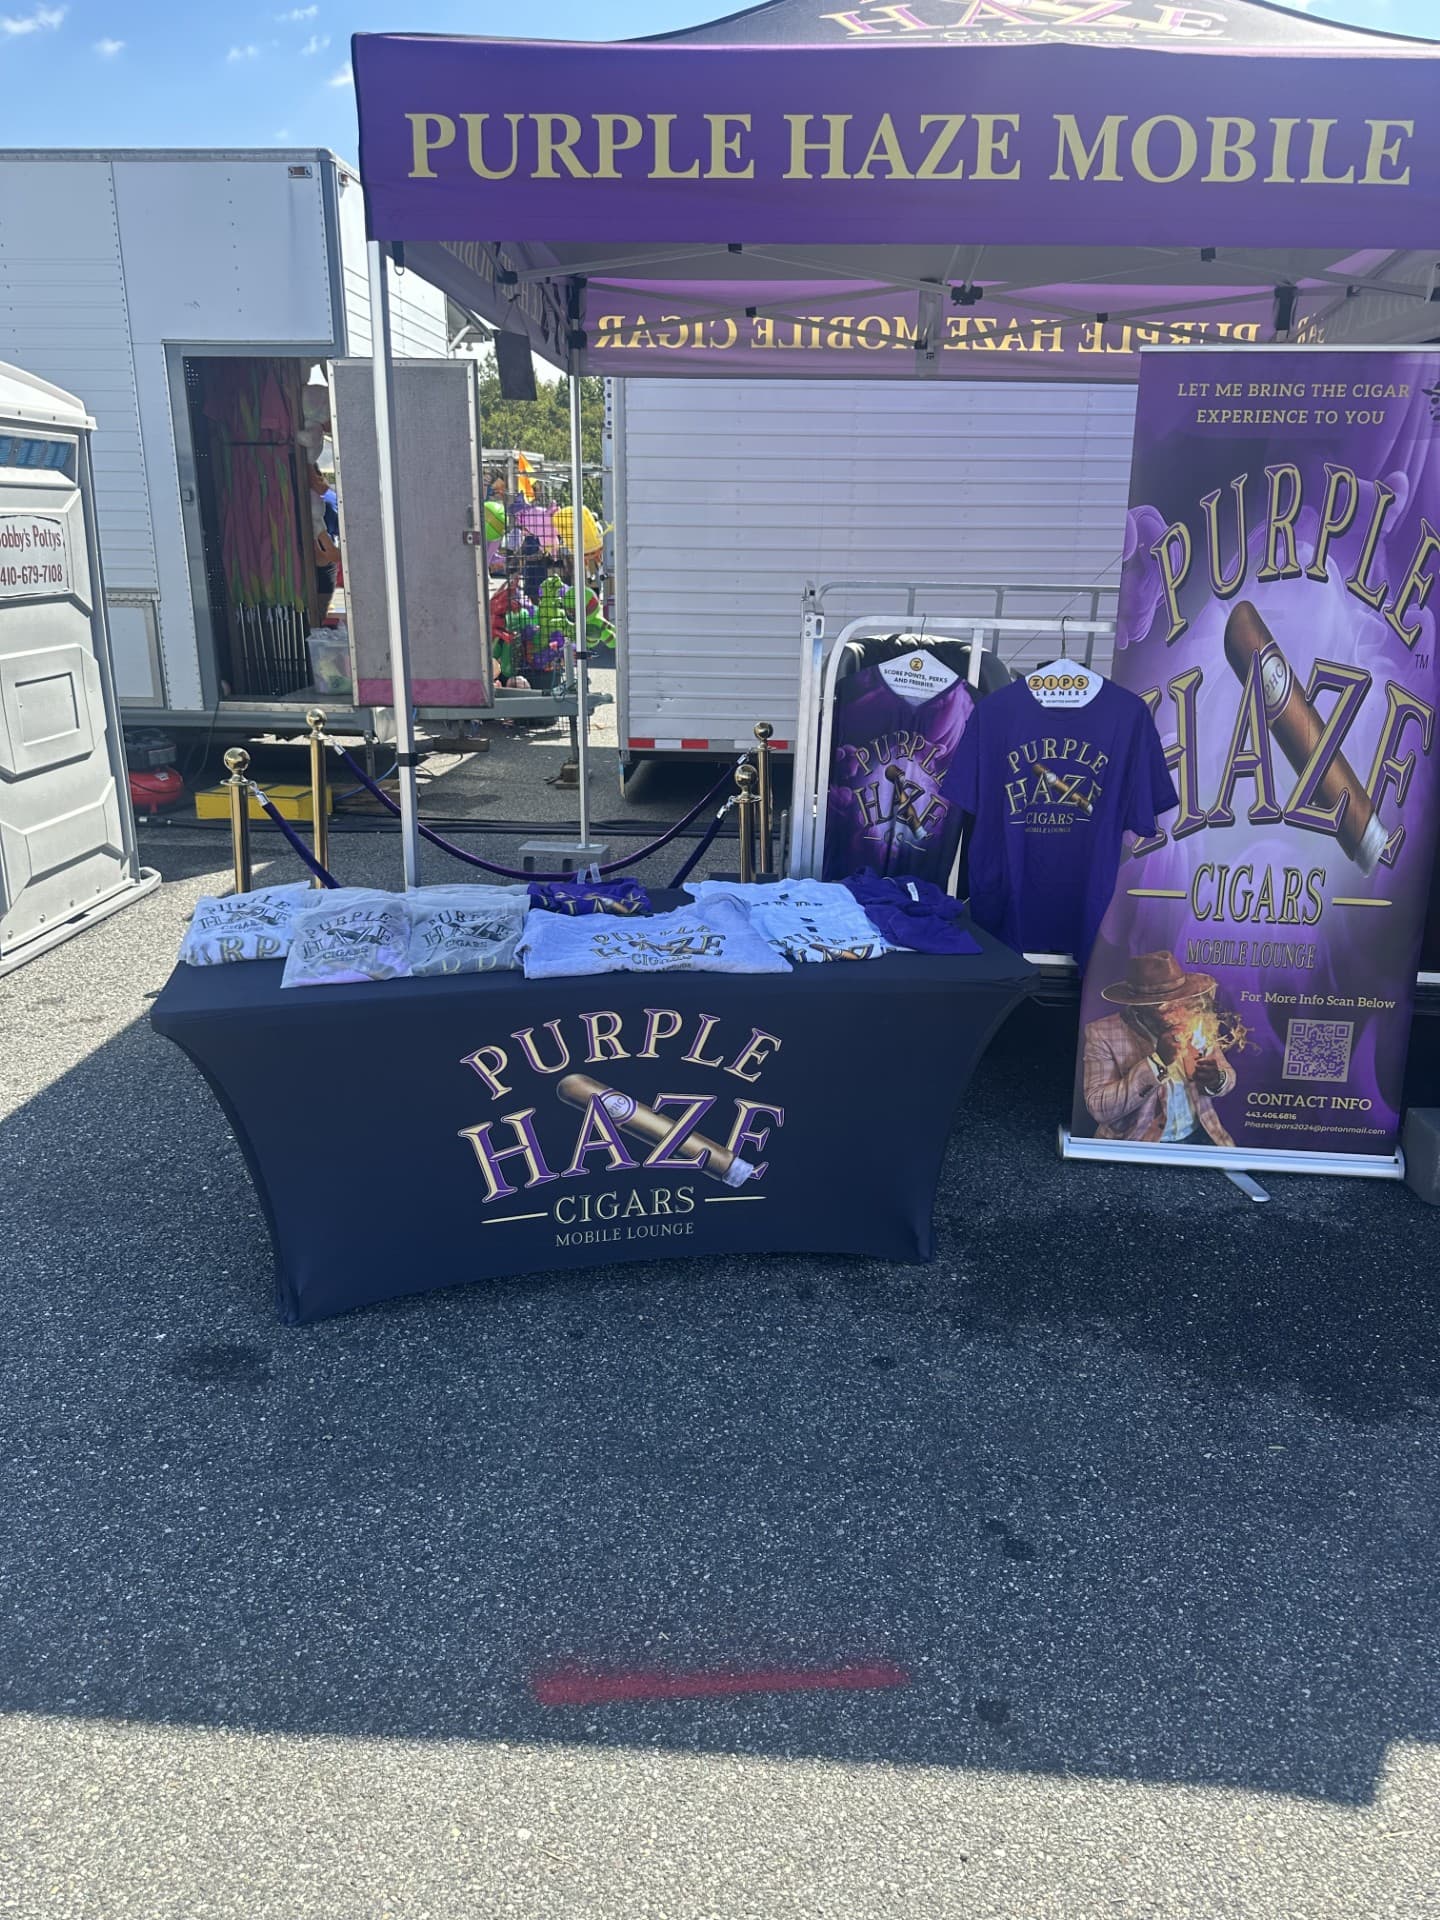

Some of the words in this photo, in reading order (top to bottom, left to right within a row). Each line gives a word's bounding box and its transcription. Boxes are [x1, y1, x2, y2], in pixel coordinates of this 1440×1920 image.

[404, 112, 755, 180] PURPLE
[782, 112, 1022, 181] HAZE
[1049, 113, 1415, 186] MOBILE
[1177, 383, 1210, 397] LET
[1215, 383, 1243, 397] ME
[1248, 383, 1306, 397] BRING
[1311, 383, 1348, 398] THE
[1352, 383, 1411, 399] CIGAR
[1196, 409, 1309, 424] EXPERIENCE
[1314, 410, 1339, 424] TO
[1345, 410, 1386, 425] YOU
[0, 524, 31, 553] obby's
[32, 524, 62, 552] Pottys
[1150, 461, 1440, 650] PURPLE
[0, 564, 63, 586] 410-679-7108
[1414, 654, 1429, 669] TM
[884, 668, 903, 676] SCORE
[929, 675, 948, 684] PERKS
[894, 676, 908, 684] AND
[1030, 677, 1086, 689] ZIPS
[1264, 663, 1284, 699] PHC
[1007, 737, 1109, 775] PURPLE
[1132, 648, 1437, 866] HAZE
[1025, 812, 1075, 825] CIGARS
[1191, 861, 1327, 926] CIGARS
[1186, 938, 1249, 966] MOBILE
[1251, 941, 1317, 969] LOUNGE
[1240, 990, 1262, 1002] For
[1264, 991, 1297, 1004] More
[1299, 993, 1325, 1006] Info
[1326, 995, 1355, 1007] Scan
[1357, 996, 1396, 1009] Below
[459, 1007, 783, 1101] PURPLE
[1247, 1092, 1328, 1109] CONTACT
[1331, 1095, 1373, 1111] INFO
[457, 1092, 786, 1204] HAZE
[554, 1186, 696, 1225] CIGARS
[555, 1227, 622, 1248] MOBILE
[626, 1222, 695, 1241] LOUNGE
